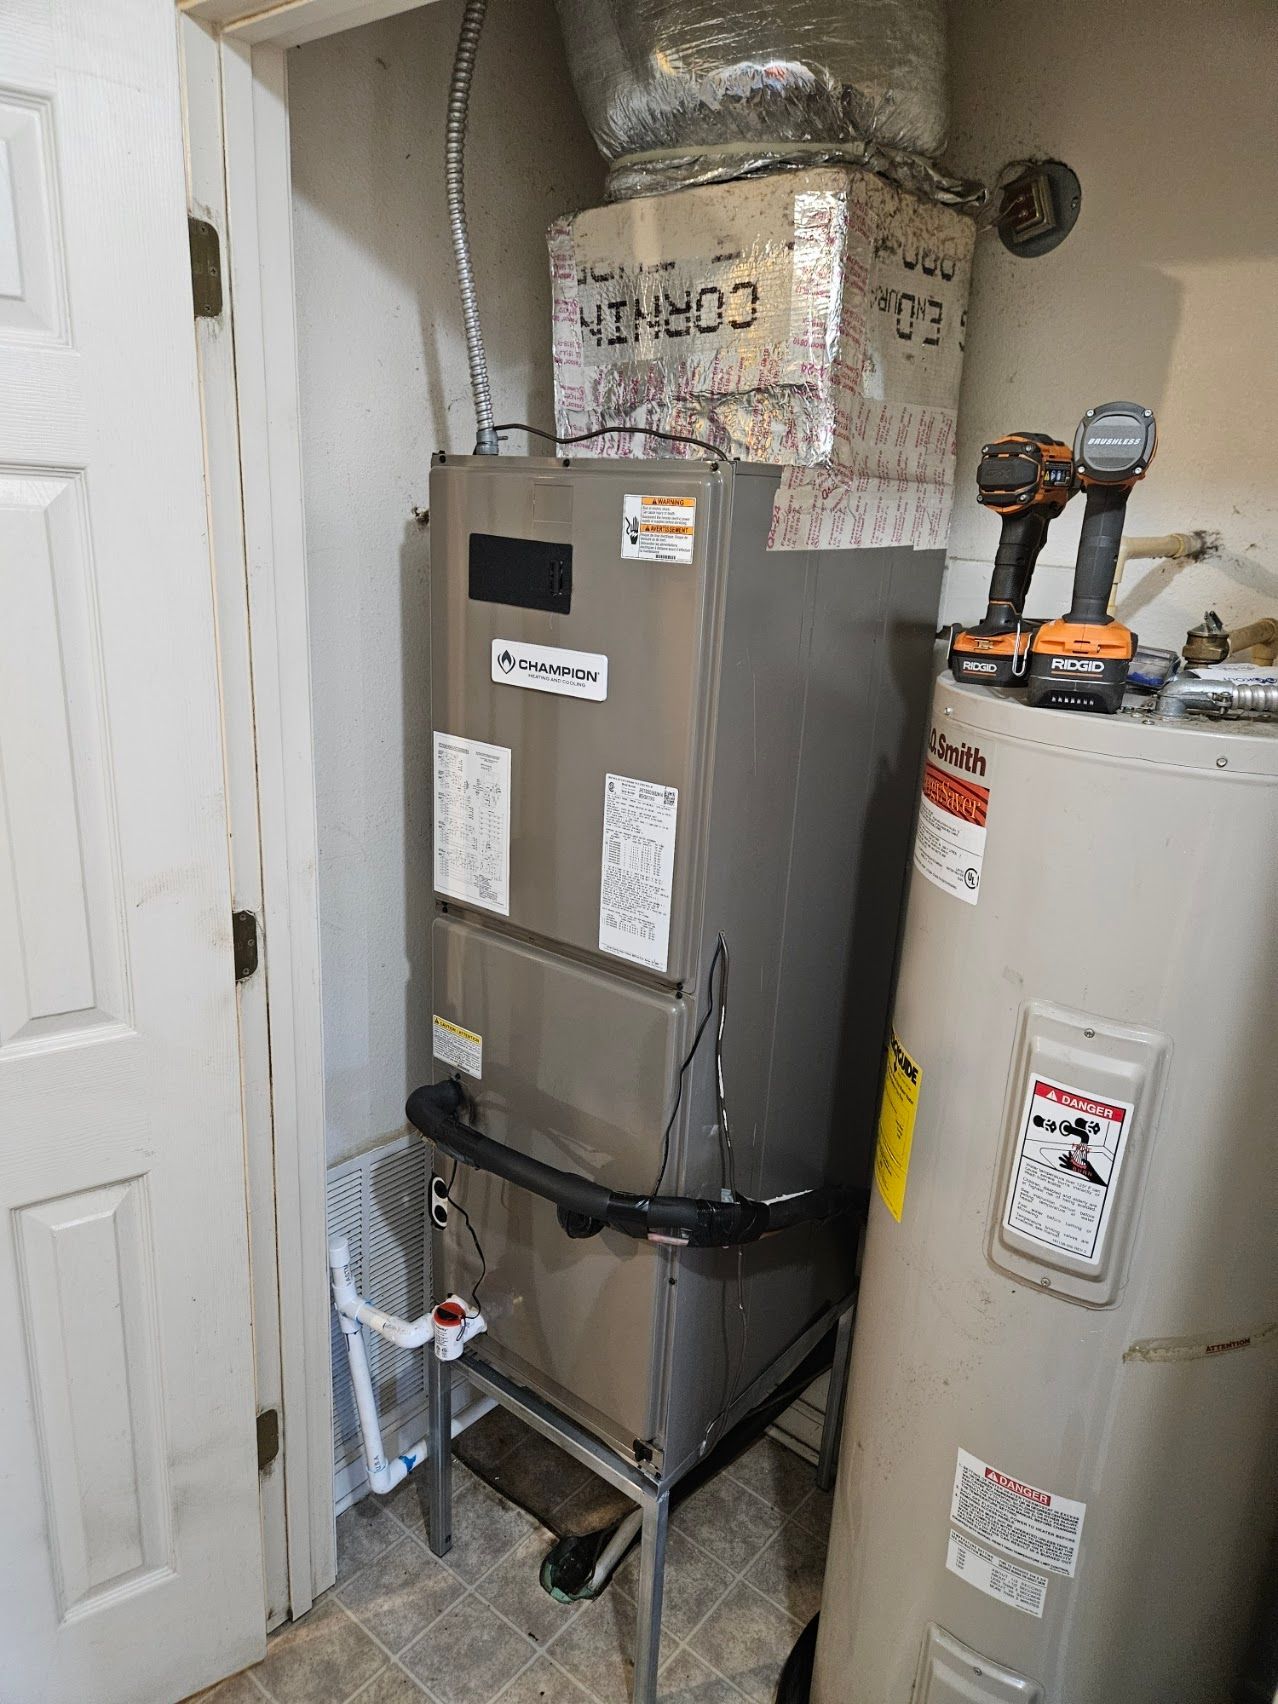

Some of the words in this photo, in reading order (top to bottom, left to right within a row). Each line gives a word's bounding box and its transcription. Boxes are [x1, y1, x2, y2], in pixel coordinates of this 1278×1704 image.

[579, 281, 760, 348] CORNIN
[1087, 438, 1141, 446] BRUSHLESS
[657, 498, 685, 506] WARNING
[767, 504, 781, 550] 04-24
[518, 658, 599, 683] CHAMPION
[962, 660, 998, 673] RIDGID
[1051, 658, 1105, 673] RIDGID
[527, 673, 550, 682] HEATING
[562, 679, 587, 688] COOLING
[937, 733, 987, 777] Smith
[891, 1038, 919, 1087] GUIDE
[1061, 1094, 1114, 1119] DANGER
[1205, 1337, 1251, 1353] ATTENTION
[999, 1477, 1049, 1505] DANGER
